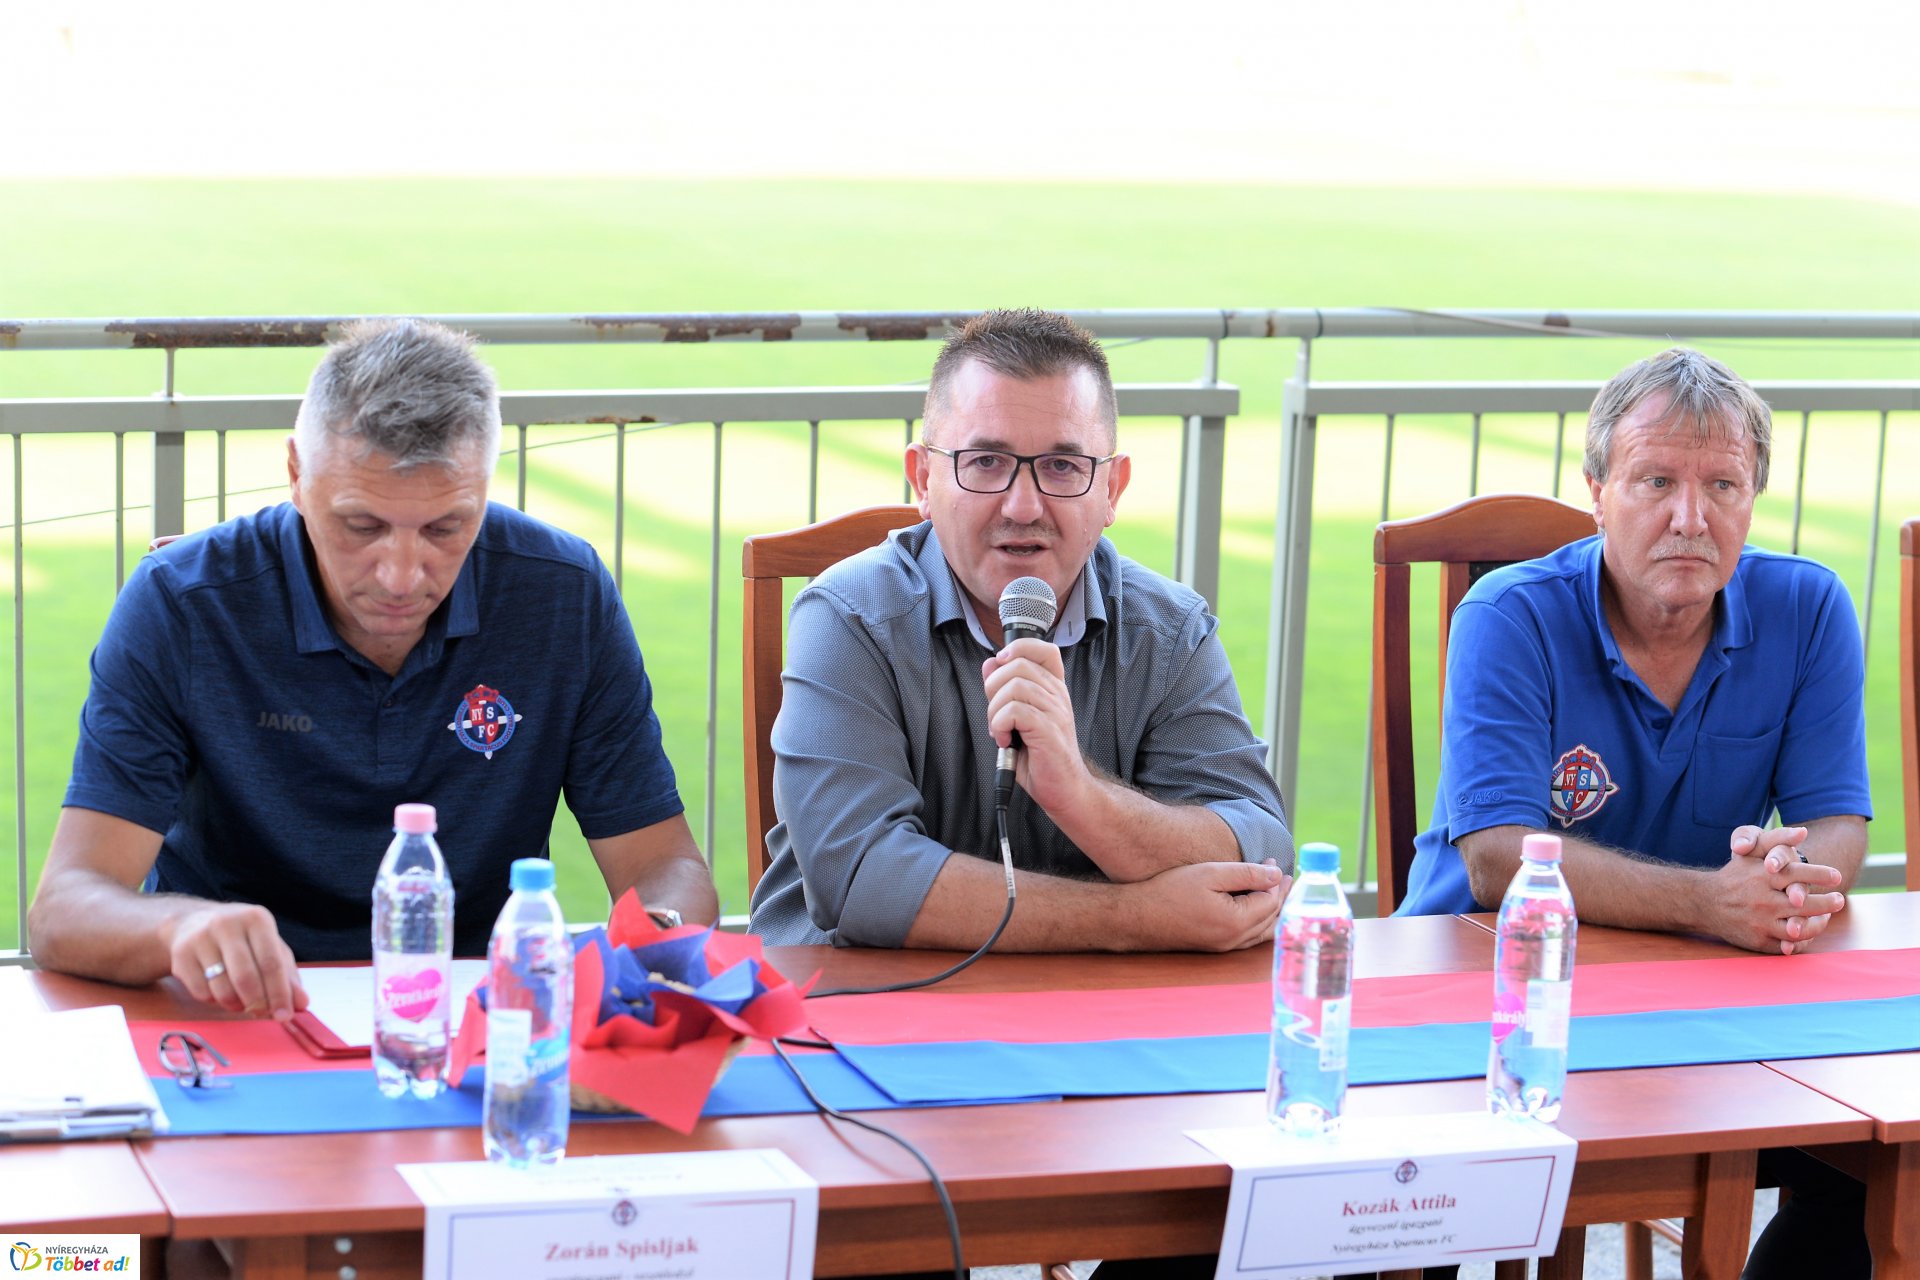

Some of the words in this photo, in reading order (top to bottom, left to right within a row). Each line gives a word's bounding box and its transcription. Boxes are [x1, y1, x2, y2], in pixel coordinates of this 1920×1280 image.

[471, 708, 483, 721] NY
[486, 707, 495, 719] S
[256, 711, 313, 733] JAKO
[478, 725, 485, 738] F
[487, 724, 495, 736] C
[1580, 773, 1588, 786] S
[1470, 791, 1503, 804] JAKO
[1566, 792, 1574, 803] F
[1576, 792, 1584, 803] C
[1342, 1197, 1399, 1216] Kozák
[1406, 1193, 1457, 1211] Attila
[545, 1240, 609, 1261] Zorán
[615, 1235, 699, 1263] Spisljak
